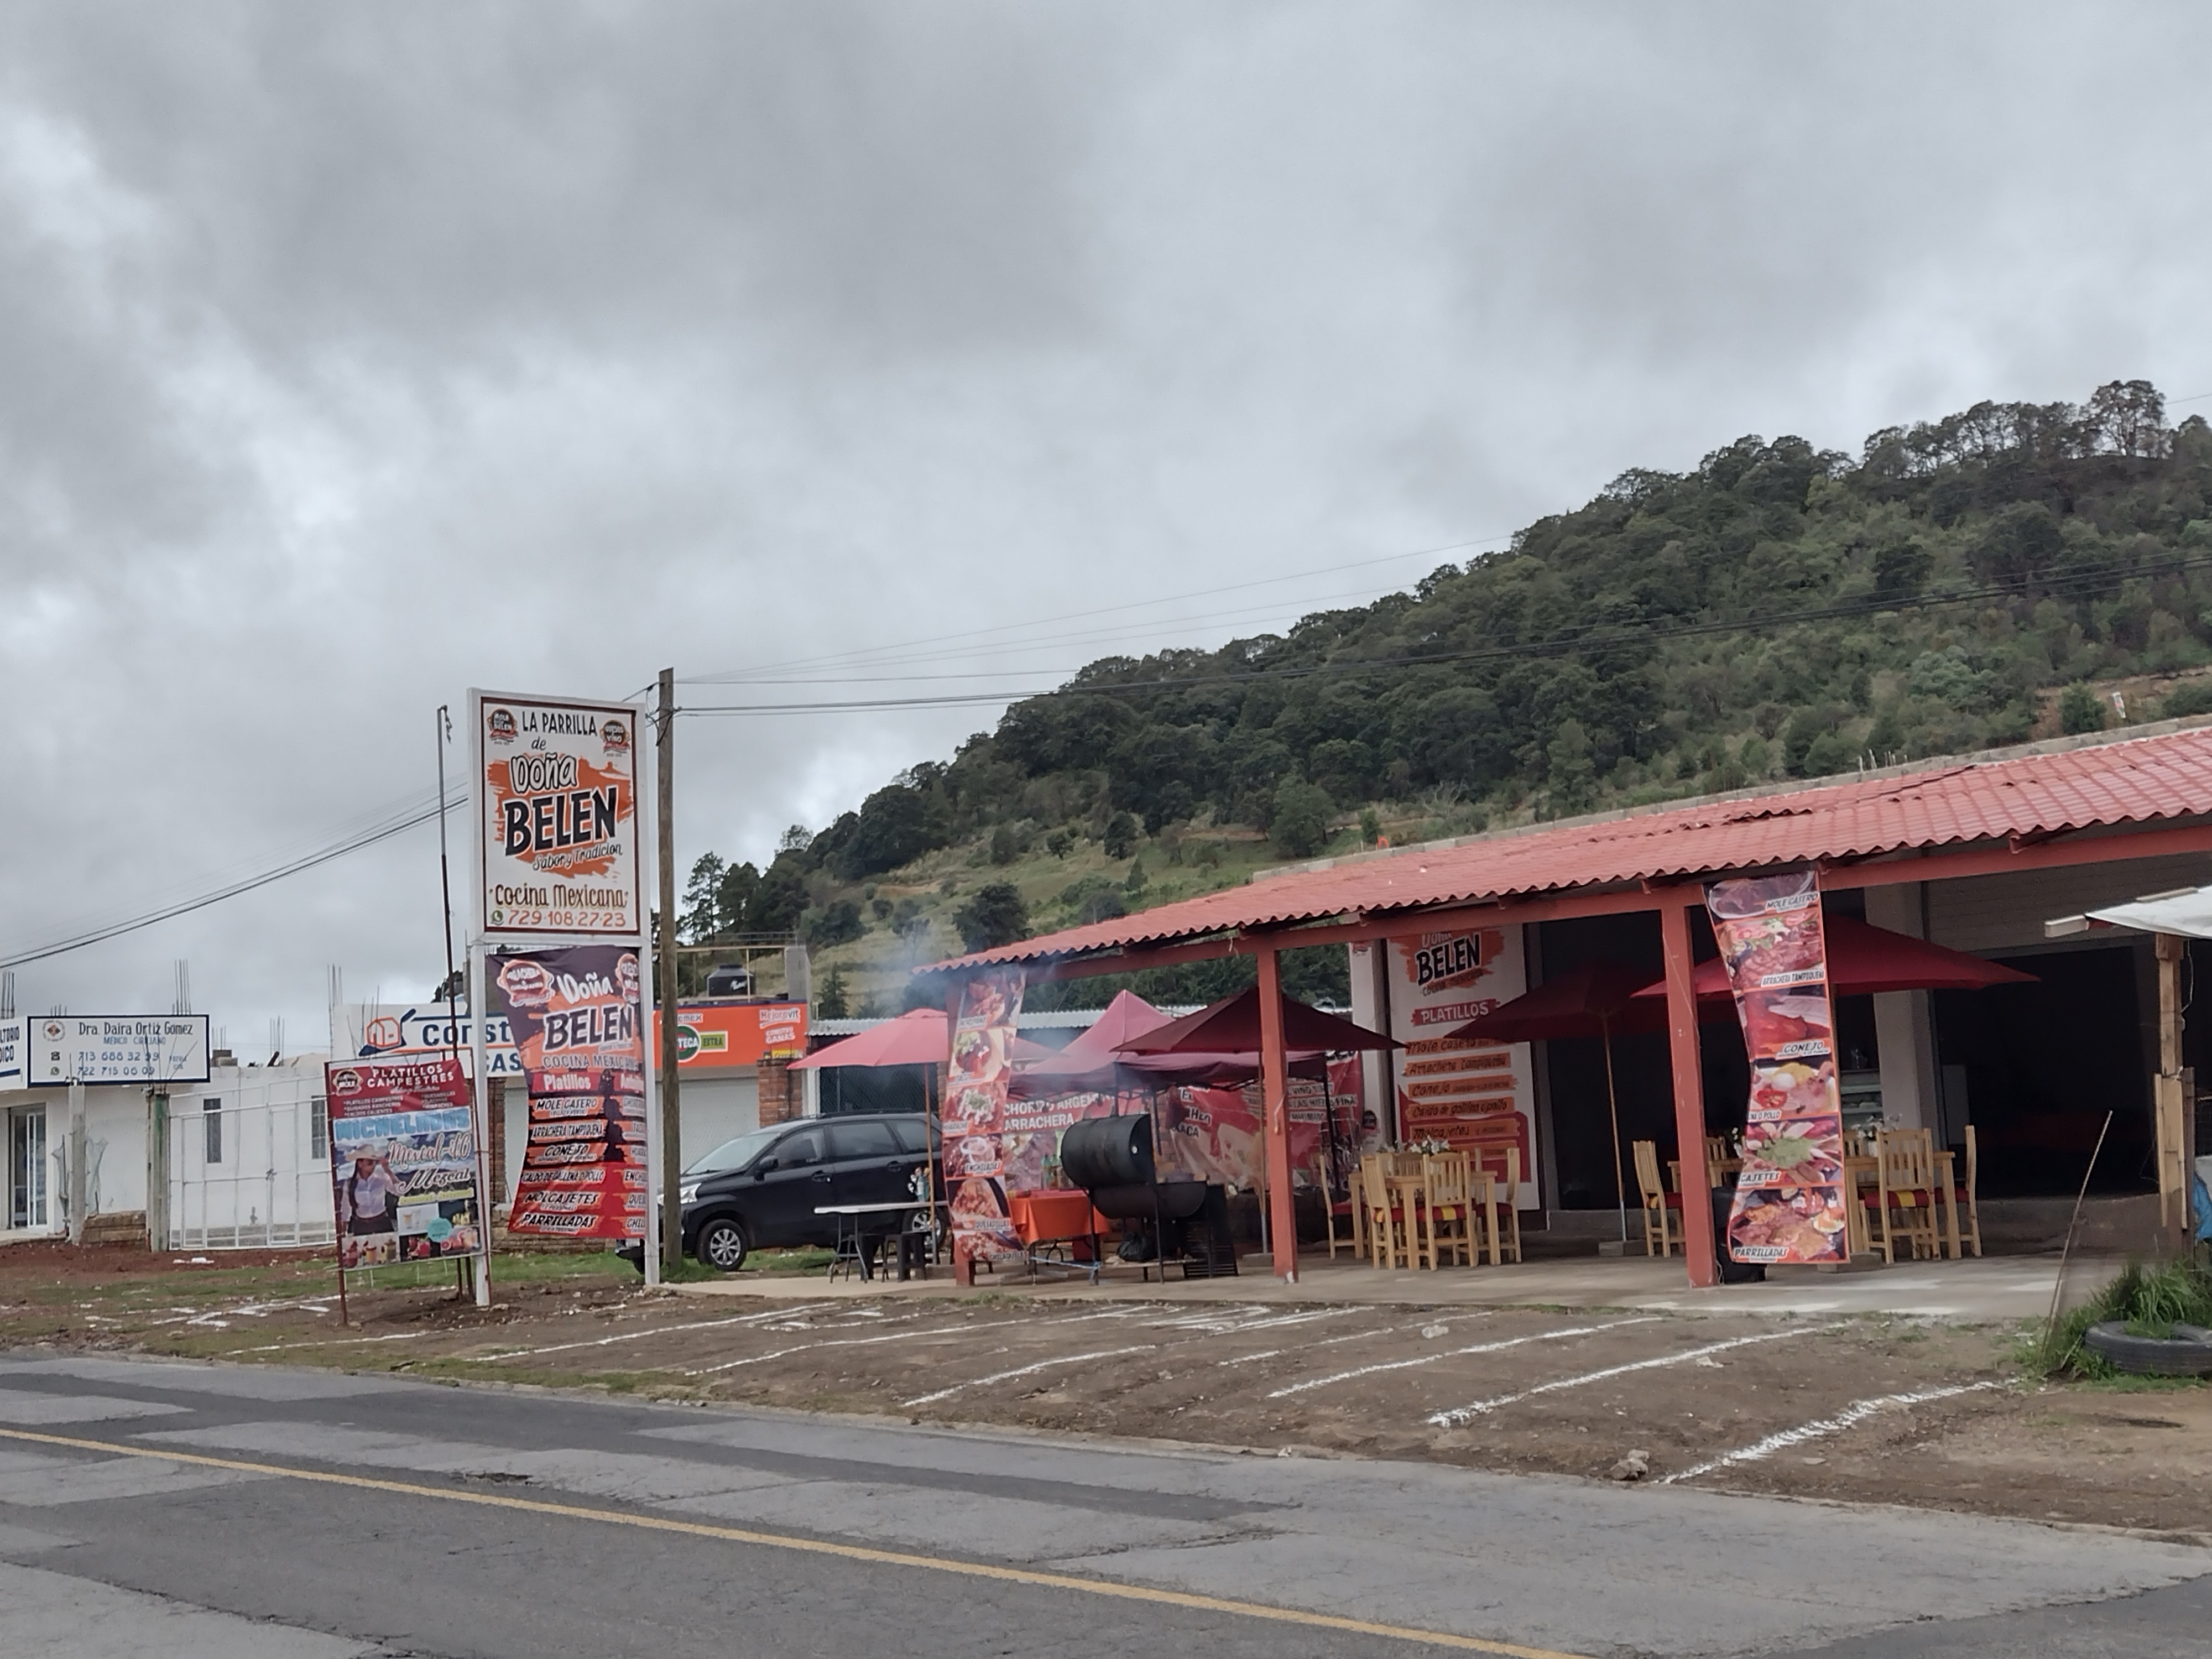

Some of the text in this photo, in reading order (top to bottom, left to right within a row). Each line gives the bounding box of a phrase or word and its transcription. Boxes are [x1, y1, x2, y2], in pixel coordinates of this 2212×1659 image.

[522, 711, 598, 737] LA PARRILLA
[531, 735, 547, 751] de
[503, 785, 619, 857] BELEN
[532, 852, 565, 871] Sabor
[1767, 898, 1788, 908] MOLE
[1415, 933, 1481, 987] BELEN
[1420, 1001, 1489, 1024] PLATILLOS
[79, 1022, 101, 1036] Dra.
[103, 1021, 132, 1036] Daira
[135, 1021, 161, 1035] Ortiz
[544, 1005, 633, 1051] BELEN
[1783, 1041, 1823, 1053] CONEJO
[127, 1051, 140, 1061] 32
[543, 1054, 589, 1069] COCINA
[123, 1066, 138, 1076] 06
[372, 1064, 443, 1078] PLATILLOS
[367, 1071, 455, 1088] CAMPESTRES
[544, 1074, 591, 1091] Platillos
[1411, 1082, 1451, 1097] Conejo
[536, 1098, 598, 1110] MOLE CASERO
[335, 1107, 469, 1141] MICHELADAS
[1004, 1113, 1074, 1131] ARRACHERA
[544, 1144, 588, 1157] CONEJO
[525, 1192, 599, 1204] MOLCAJETES
[521, 1213, 596, 1228] PARRILLADAS
[1734, 1248, 1787, 1257] PARRILLADAS
